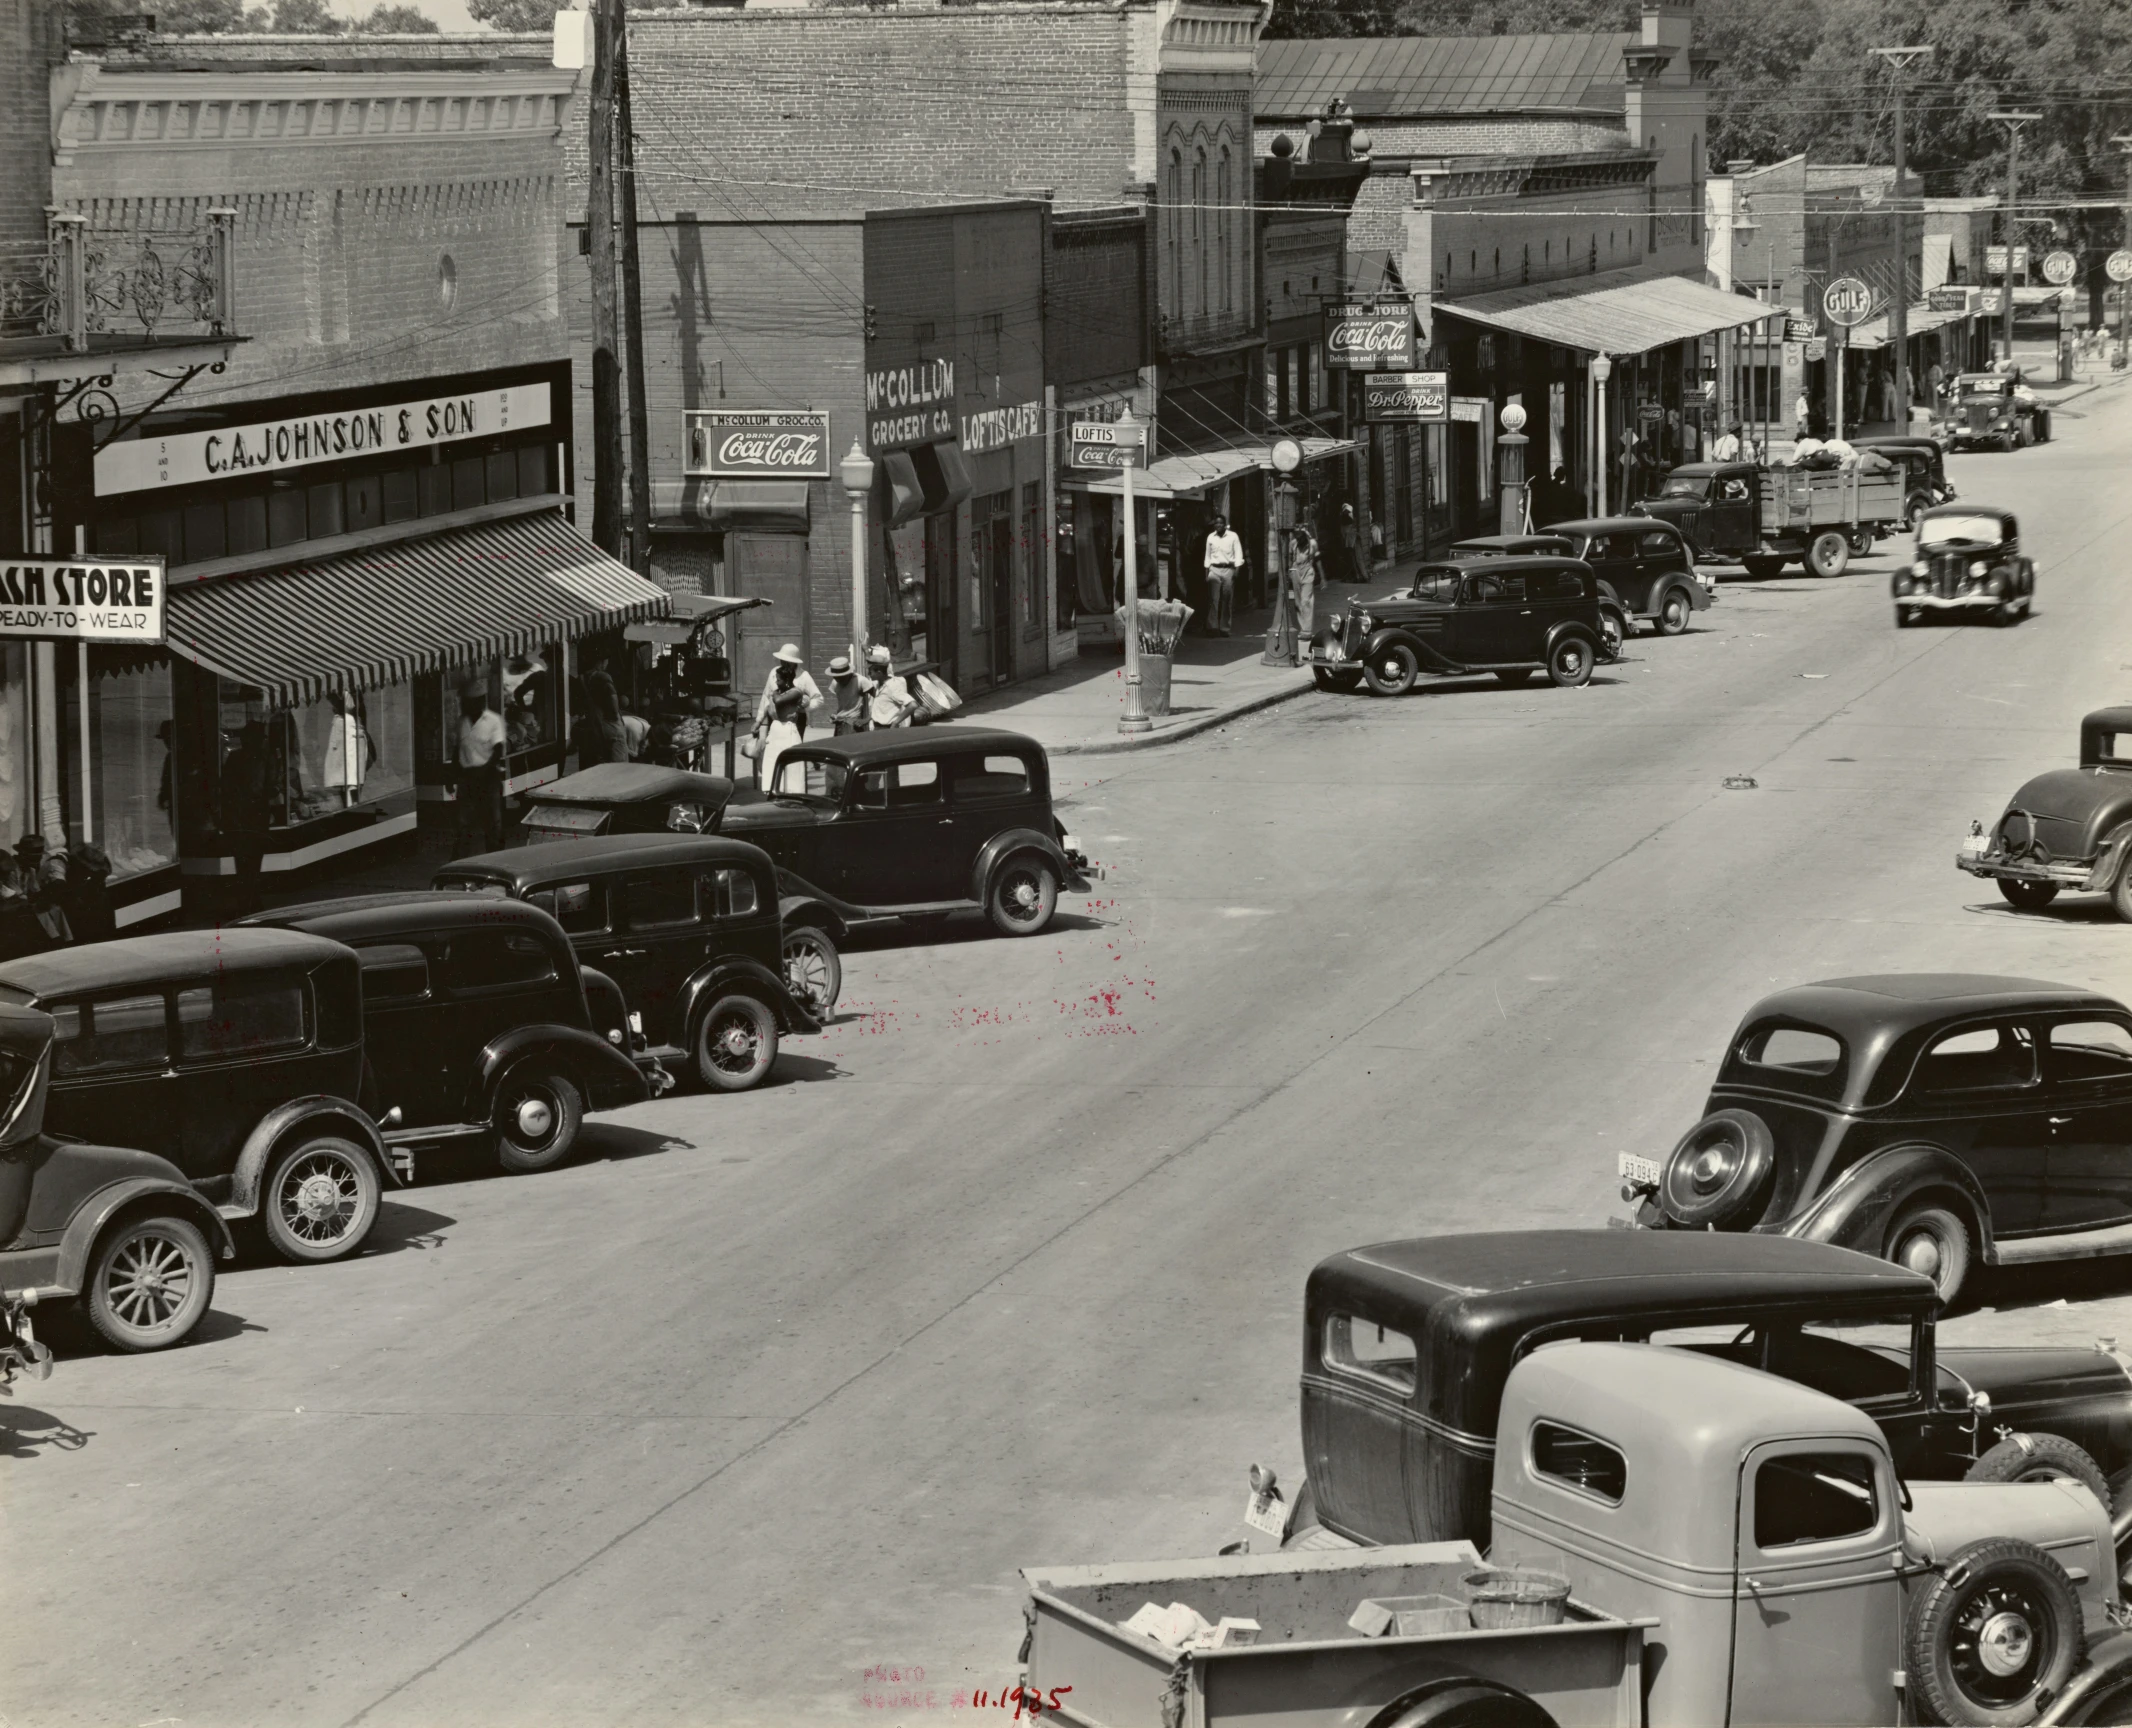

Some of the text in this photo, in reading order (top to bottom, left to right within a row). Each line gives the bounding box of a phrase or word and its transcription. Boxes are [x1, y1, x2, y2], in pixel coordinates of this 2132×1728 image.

[2045, 261, 2073, 276] GULF
[1826, 289, 1869, 314] GULF
[1328, 307, 1363, 317] DRUG
[1785, 321, 1813, 333] Exide
[1328, 320, 1409, 351] Coca-Cola
[1329, 353, 1409, 364] Delicious and Refreshing
[1372, 374, 1436, 384] BARBER SHOP
[398, 409, 413, 444] &
[425, 399, 476, 438] SON
[1503, 411, 1521, 424] GULF
[872, 410, 951, 446] GROCERY CO.
[961, 408, 1006, 451] LOFTIS
[1075, 427, 1113, 441] LOFTIS
[160, 442, 166, 453] 5
[719, 432, 821, 466] Coca-Cola
[158, 457, 169, 466] AND
[160, 470, 168, 482] 10
[53, 567, 154, 607] STORE
